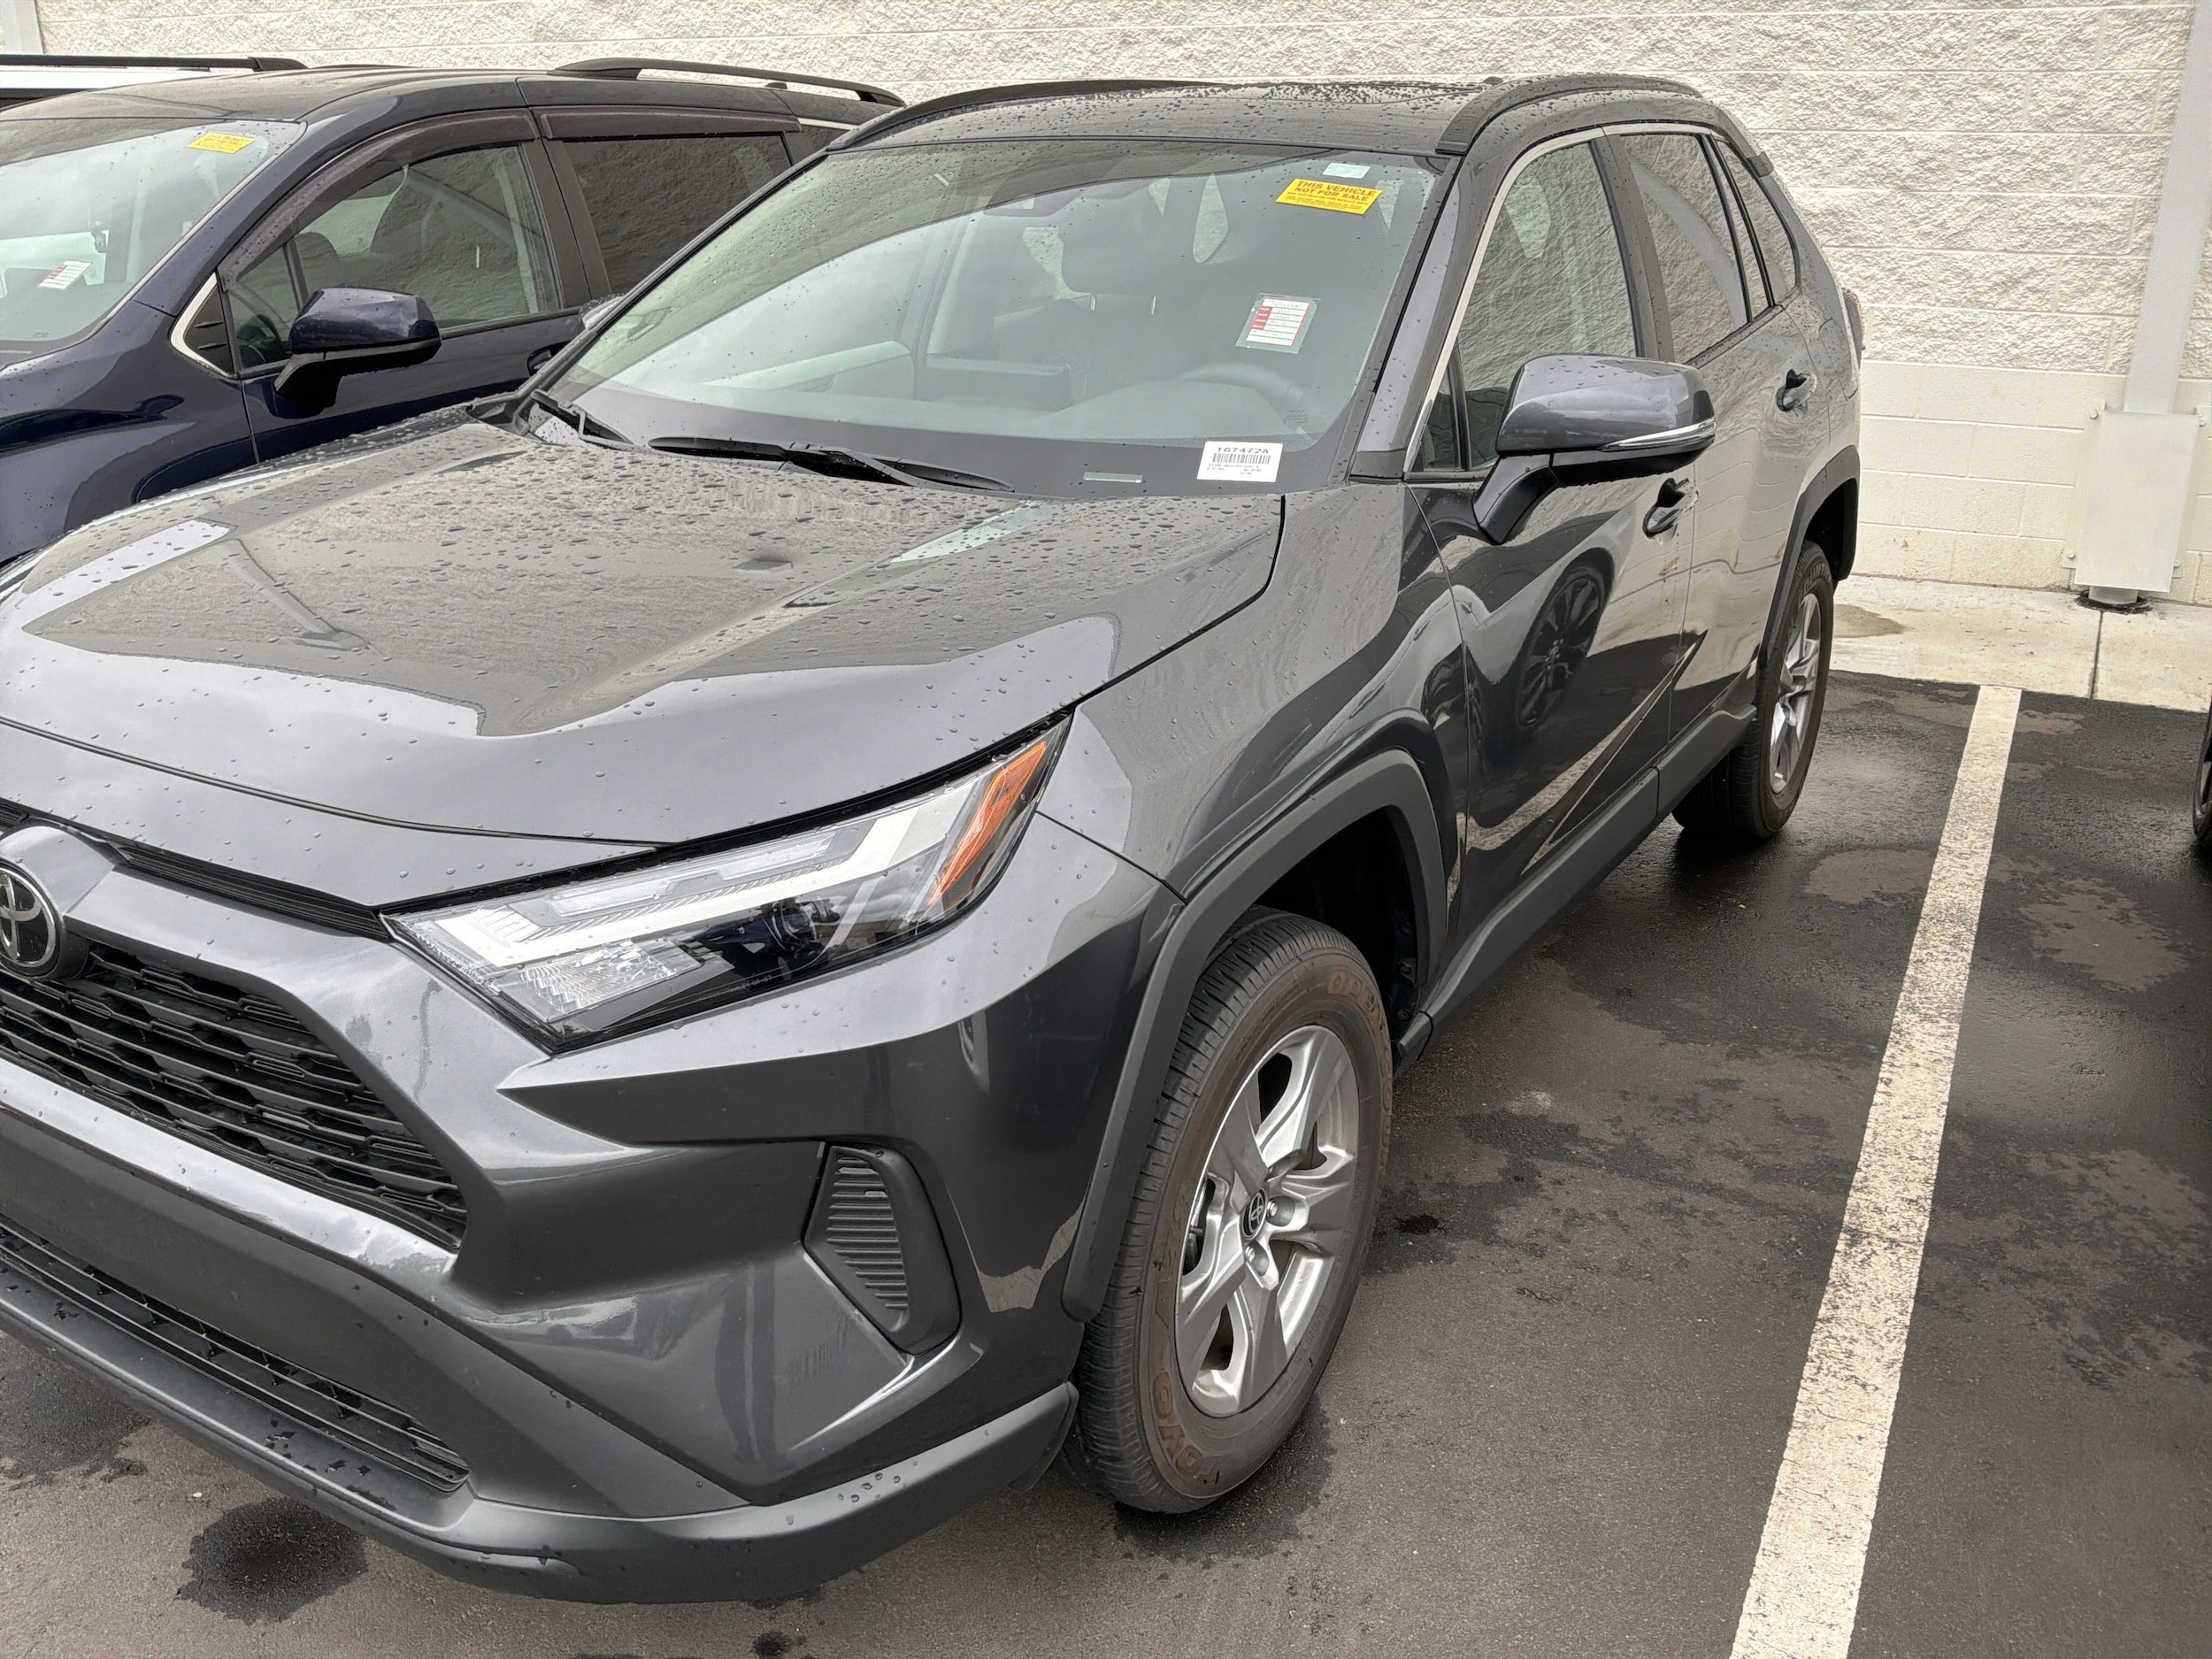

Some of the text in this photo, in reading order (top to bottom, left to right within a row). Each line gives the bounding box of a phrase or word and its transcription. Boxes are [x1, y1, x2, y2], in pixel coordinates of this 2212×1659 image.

[1296, 180, 1378, 197] THIS VEHICLE
[1327, 970, 1385, 1037] OPEN
[1153, 1371, 1220, 1486] TOYO
